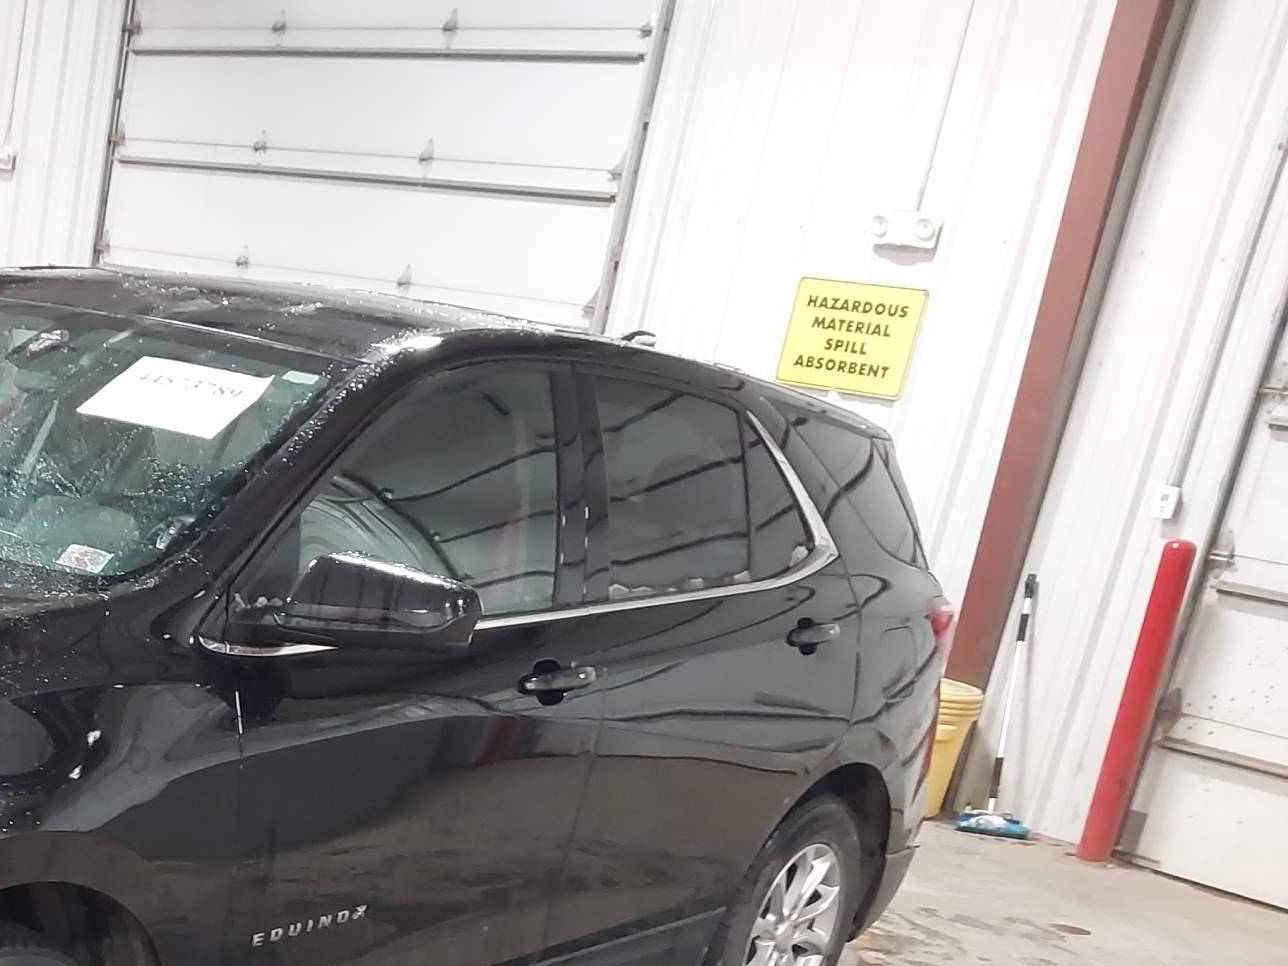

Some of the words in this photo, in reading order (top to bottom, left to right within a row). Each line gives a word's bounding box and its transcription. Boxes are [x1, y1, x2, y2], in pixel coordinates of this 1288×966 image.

[807, 294, 909, 318] HAZARDOUS
[811, 316, 891, 337] MATERIAL
[824, 338, 867, 355] SPILL
[793, 354, 890, 379] ABSORBENT
[252, 904, 368, 947] EQUINOX
